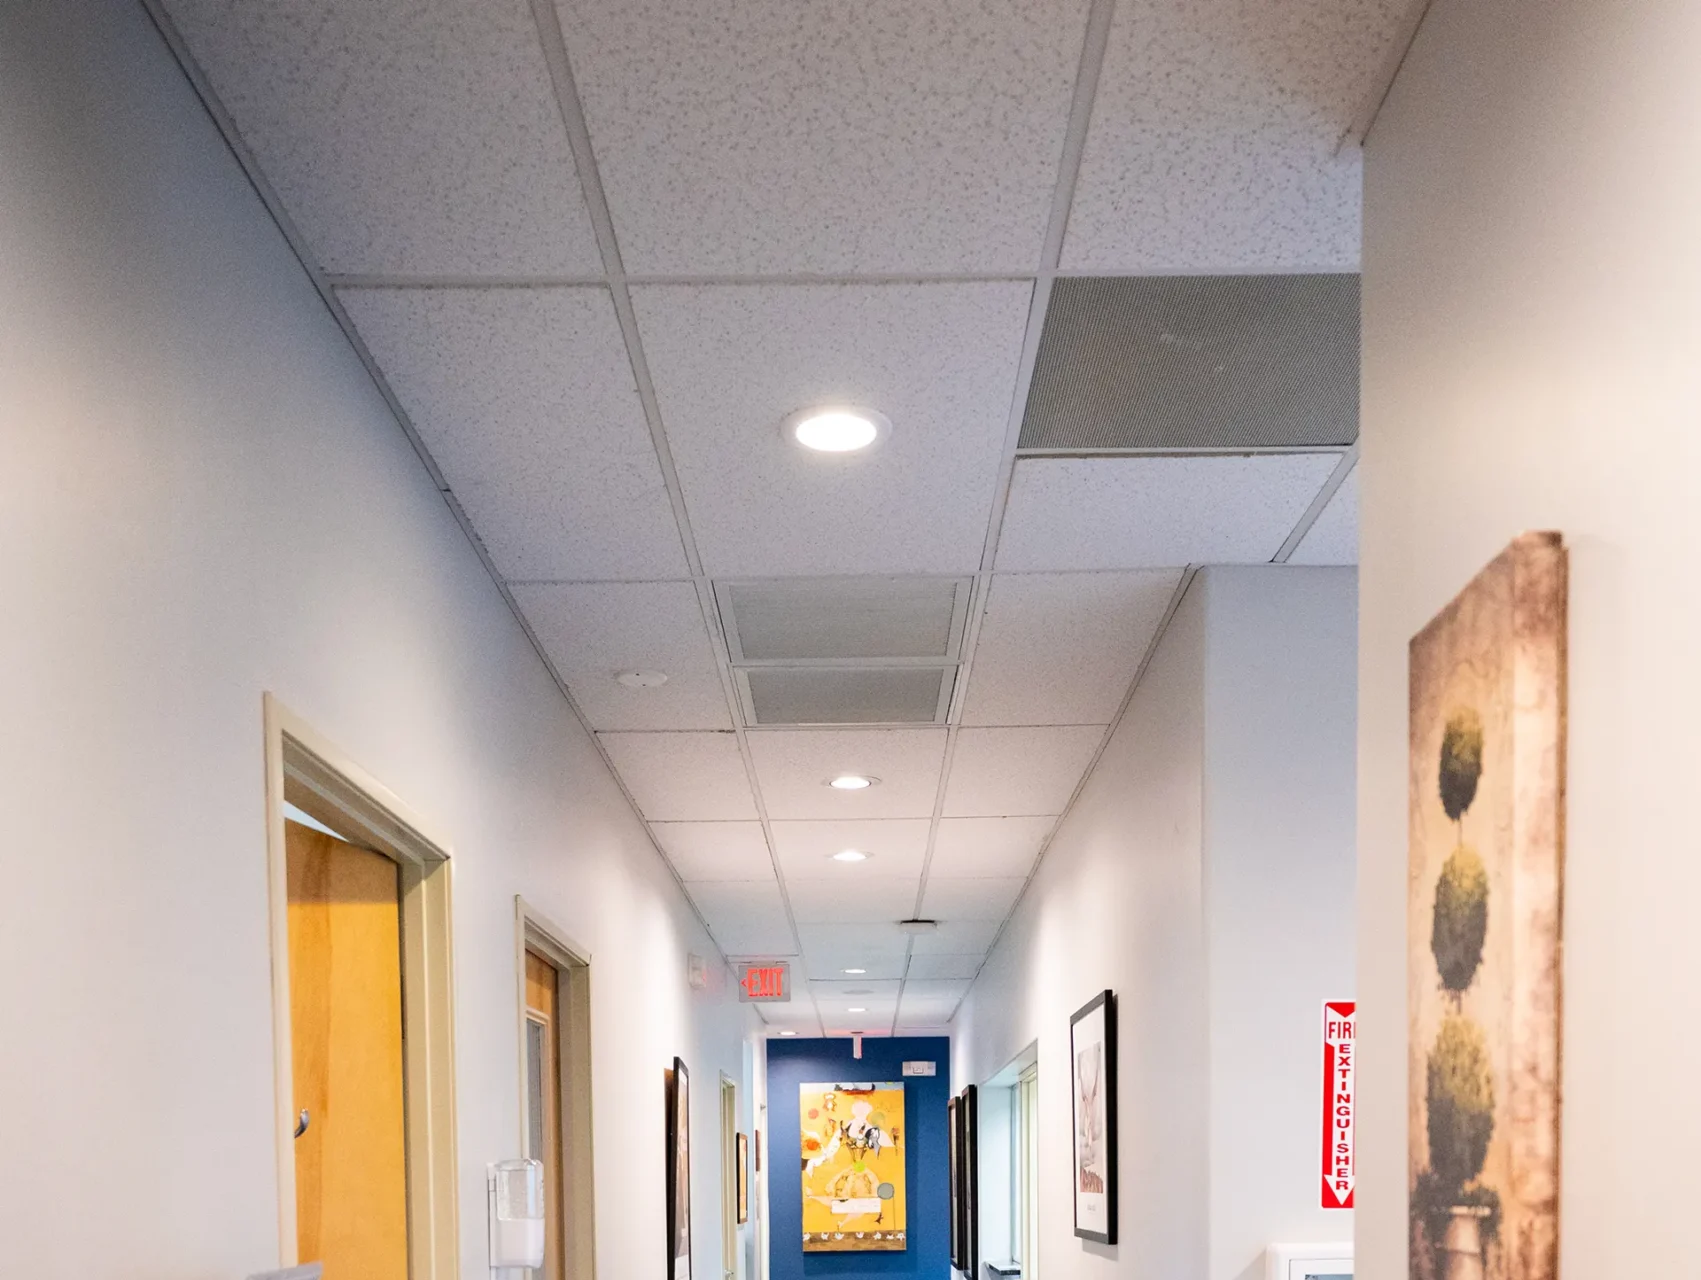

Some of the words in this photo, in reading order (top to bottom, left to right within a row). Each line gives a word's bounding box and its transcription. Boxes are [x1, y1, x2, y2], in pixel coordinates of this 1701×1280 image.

[747, 968, 783, 997] EXIT
[1328, 1021, 1356, 1039] FIR
[1335, 1043, 1351, 1190] EXTINGUISHER
